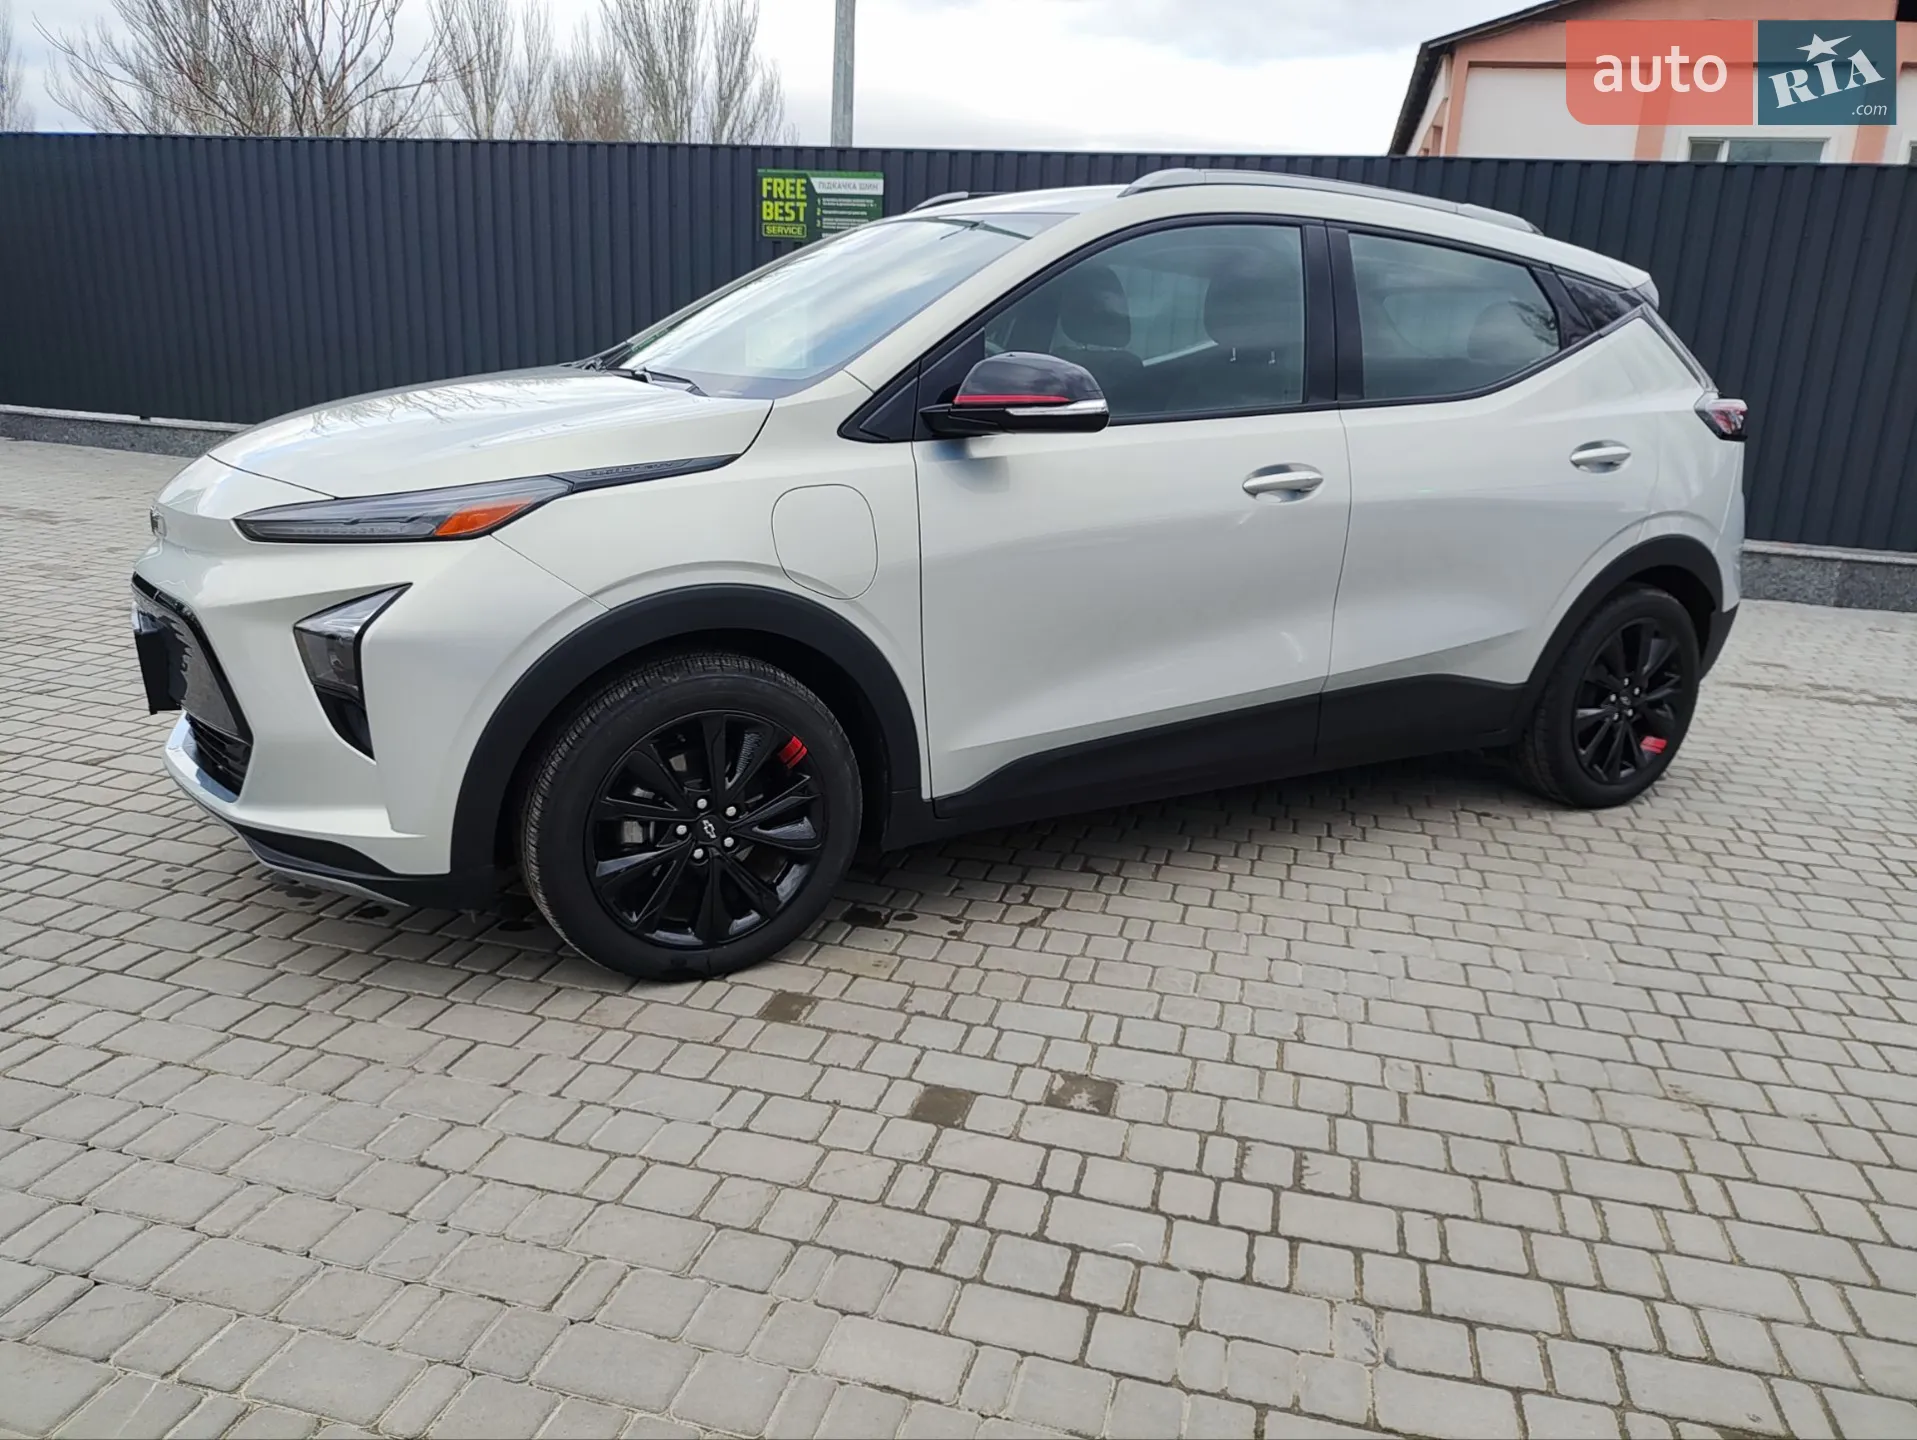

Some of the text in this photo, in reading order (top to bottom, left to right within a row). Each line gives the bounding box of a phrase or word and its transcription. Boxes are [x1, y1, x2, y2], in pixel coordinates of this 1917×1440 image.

[762, 178, 807, 199] FREE
[818, 181, 857, 191] ПІДКАЧКА
[762, 201, 807, 222] BEST
[766, 226, 803, 235] SERVICE
